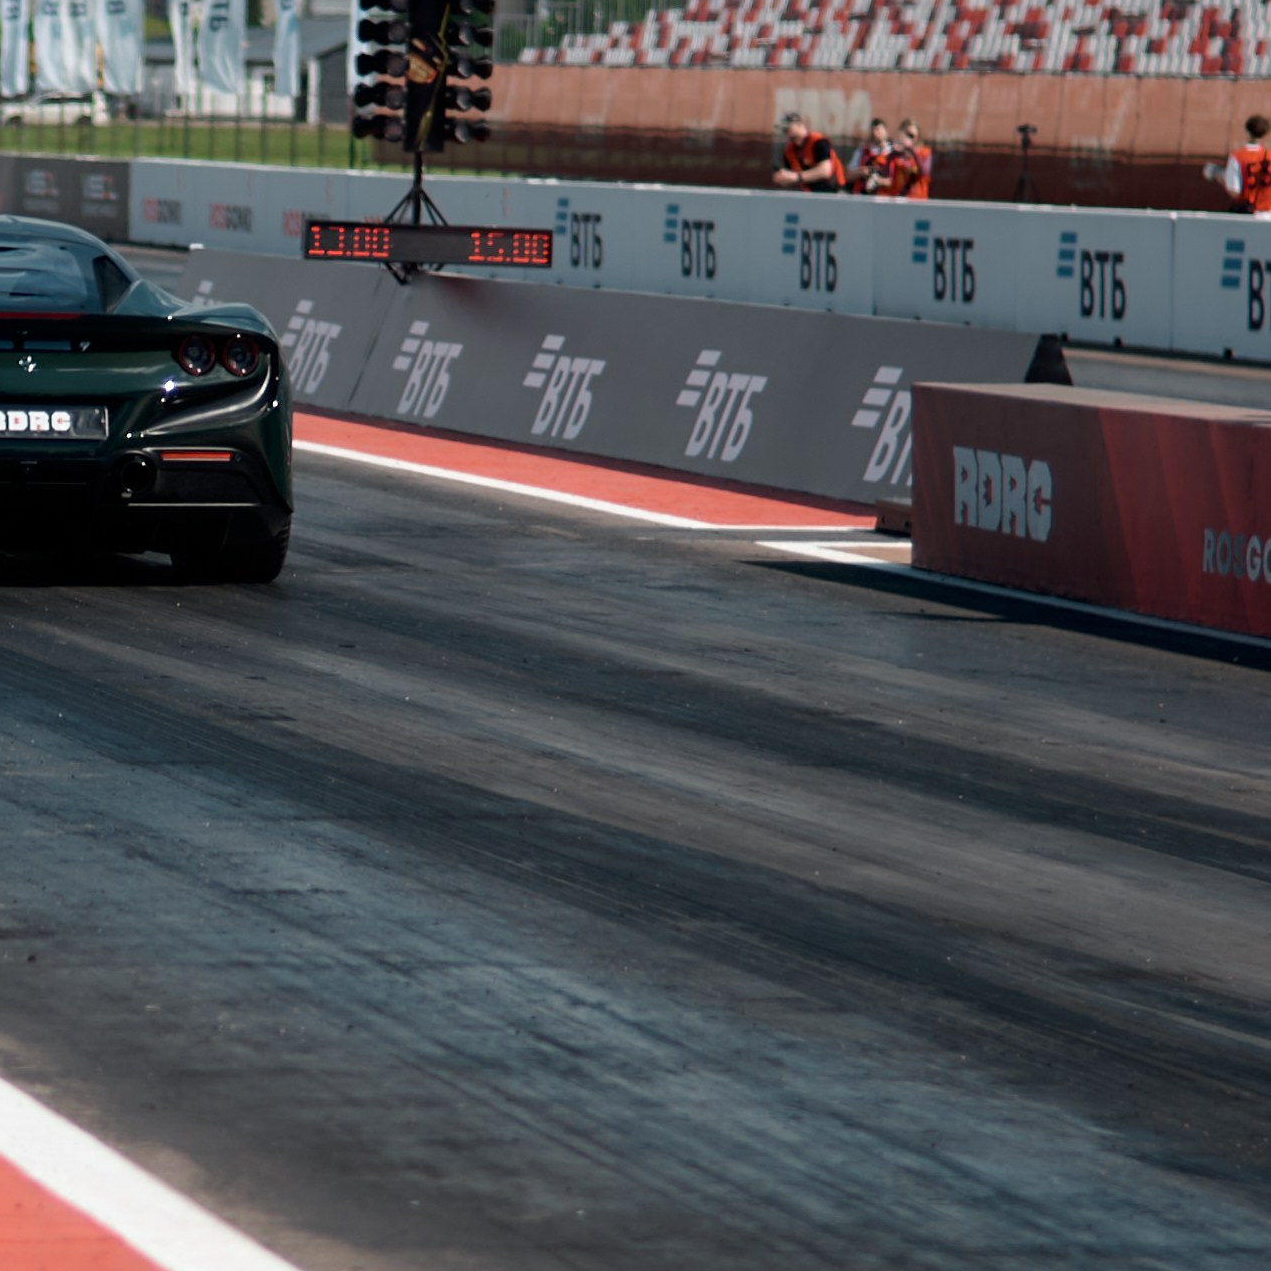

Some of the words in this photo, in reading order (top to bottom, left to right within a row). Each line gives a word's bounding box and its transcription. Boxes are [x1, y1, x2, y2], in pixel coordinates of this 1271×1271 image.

[570, 212, 602, 268] ВТБ
[681, 219, 716, 279] ВТБ
[800, 229, 838, 293] ВТБ
[933, 237, 976, 303] ВТБ
[1080, 250, 1127, 320] ВТБ
[288, 319, 342, 394] ВТБ
[396, 340, 463, 419] ВТБ
[531, 355, 606, 440] ВТБ
[684, 371, 768, 462] ВТБ
[953, 445, 1053, 543] RDRC
